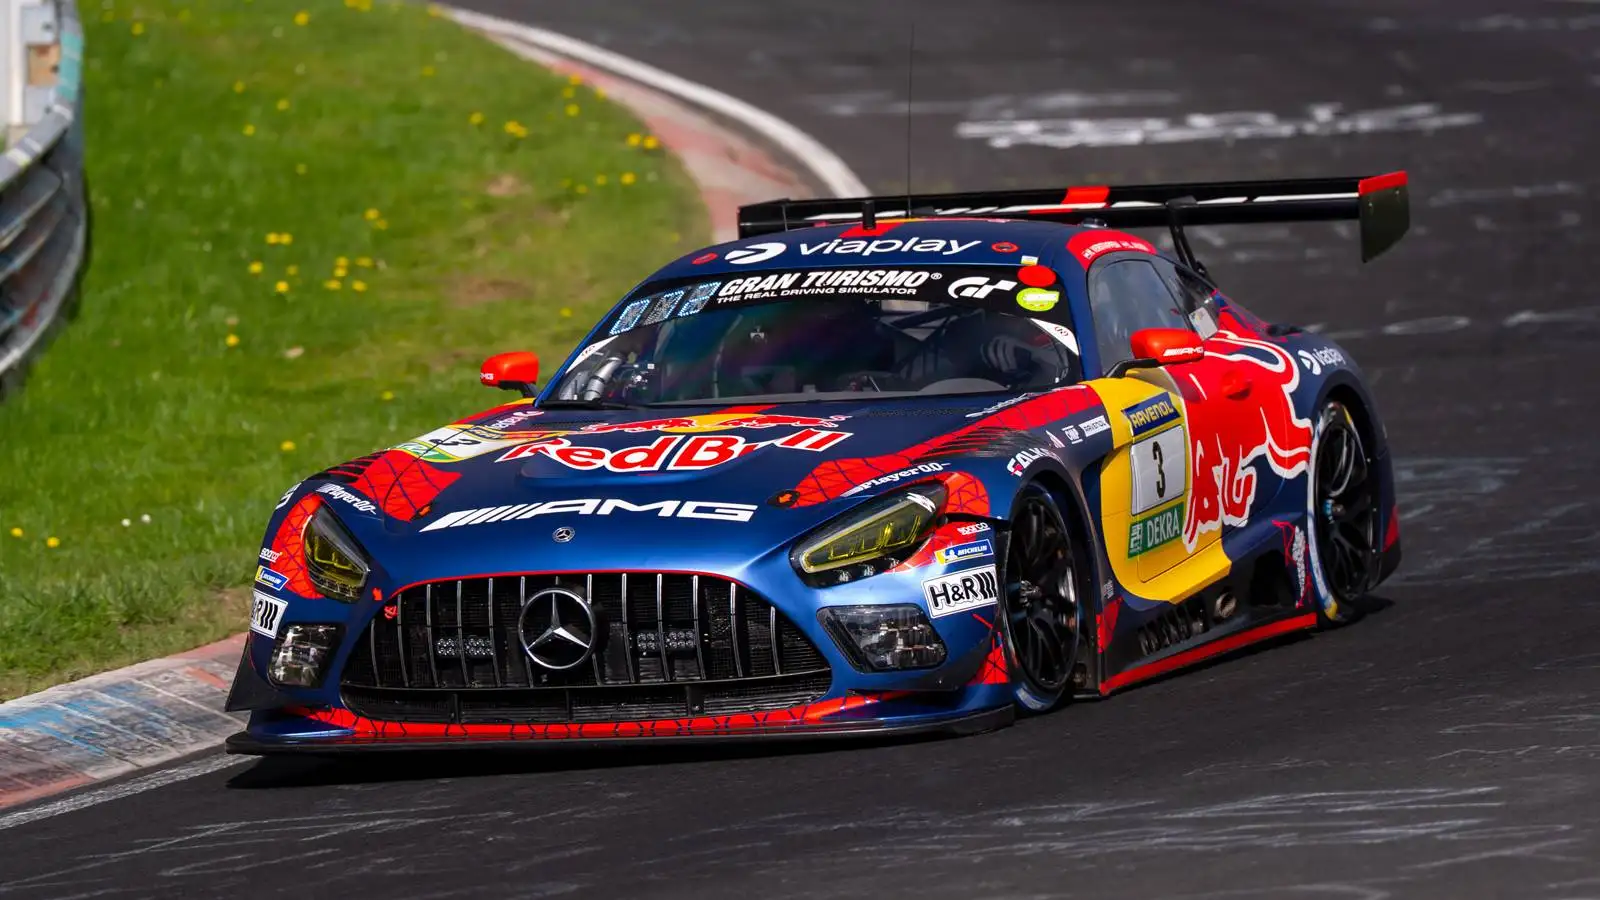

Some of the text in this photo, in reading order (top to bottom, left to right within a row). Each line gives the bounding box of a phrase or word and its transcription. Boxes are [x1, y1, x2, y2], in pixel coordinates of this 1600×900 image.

[799, 236, 982, 256] viaplay
[716, 286, 917, 304] THE REAL DRIVING SIMULATOR
[718, 272, 802, 297] GRAN
[1131, 400, 1174, 428] RAVENOL
[494, 435, 684, 473] Red
[854, 467, 919, 491] Player
[1152, 441, 1166, 499] 3
[523, 498, 759, 523] AMG
[1147, 508, 1181, 548] DEKRA
[957, 545, 988, 556] MICHELIN
[929, 577, 979, 608] H&R
